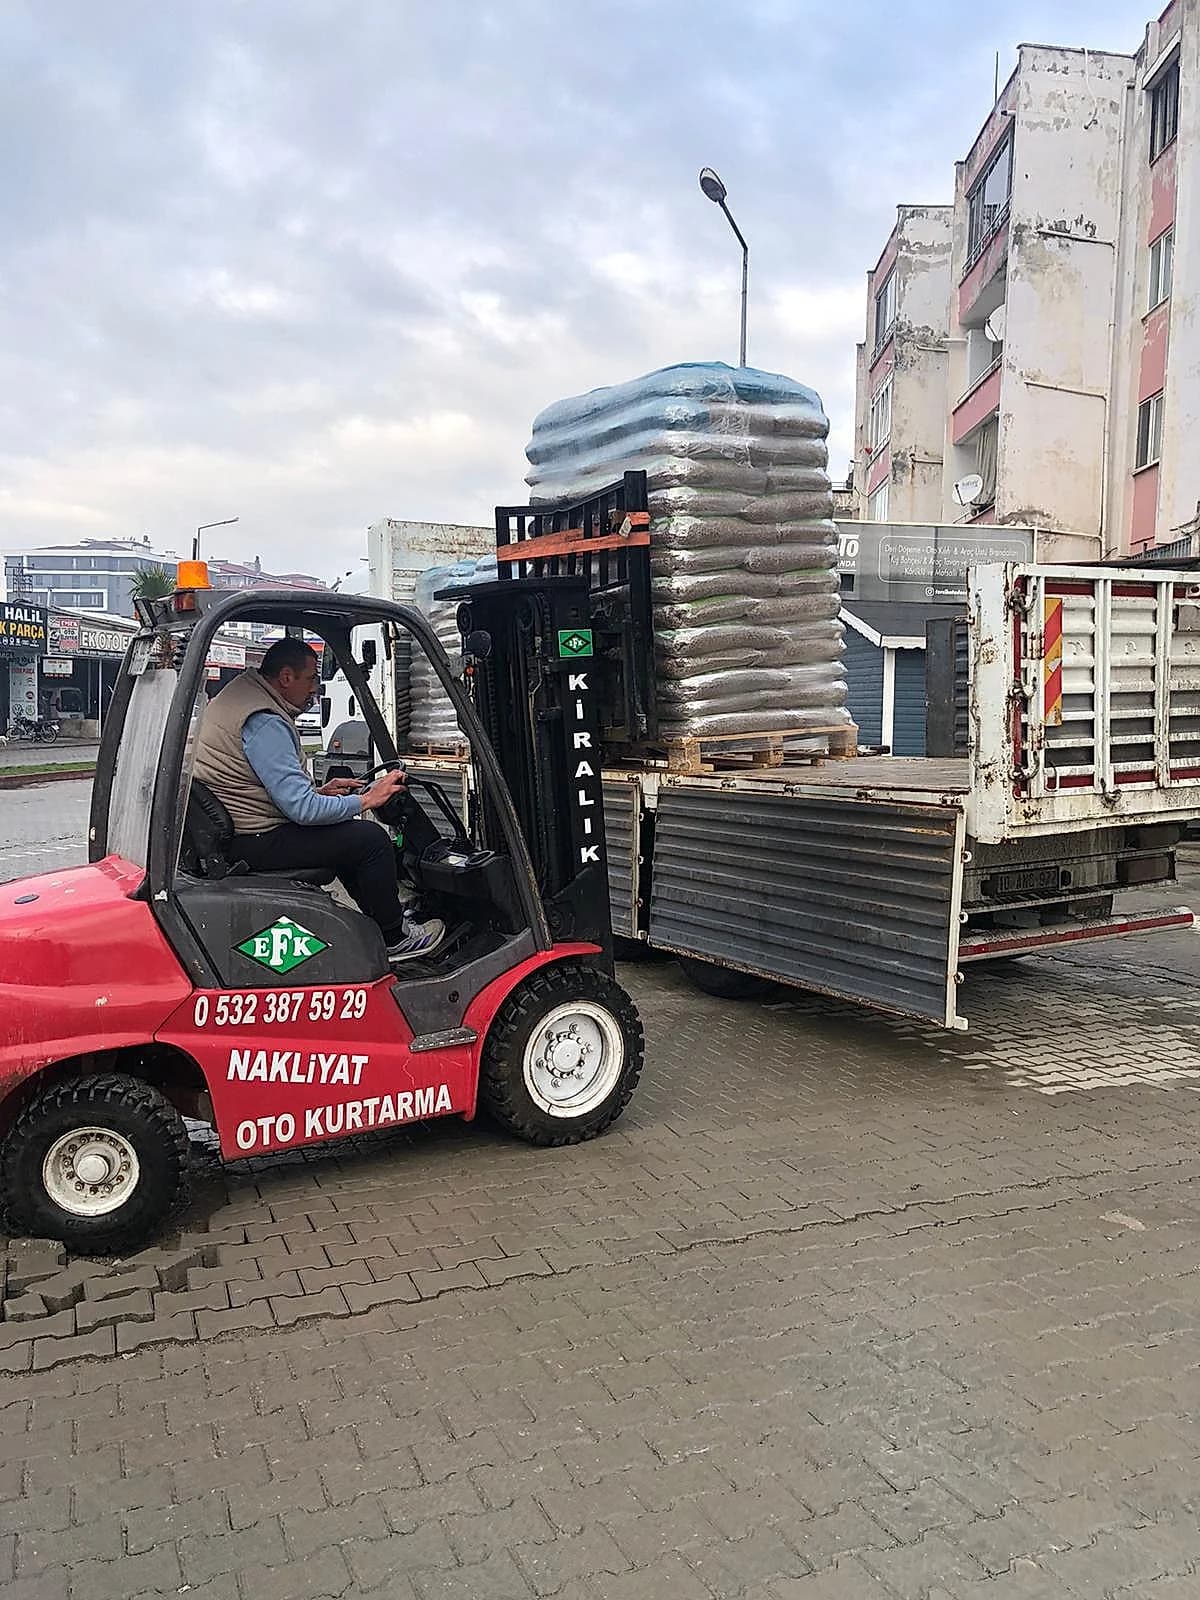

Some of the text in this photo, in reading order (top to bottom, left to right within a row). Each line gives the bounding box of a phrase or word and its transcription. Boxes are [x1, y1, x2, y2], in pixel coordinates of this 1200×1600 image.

[837, 534, 860, 558] TO
[9, 622, 45, 640] PARÇA
[253, 927, 314, 967] EFK
[194, 989, 367, 1027] 0 532 387 59 29
[236, 1084, 452, 1150] OTO KURTARMA
